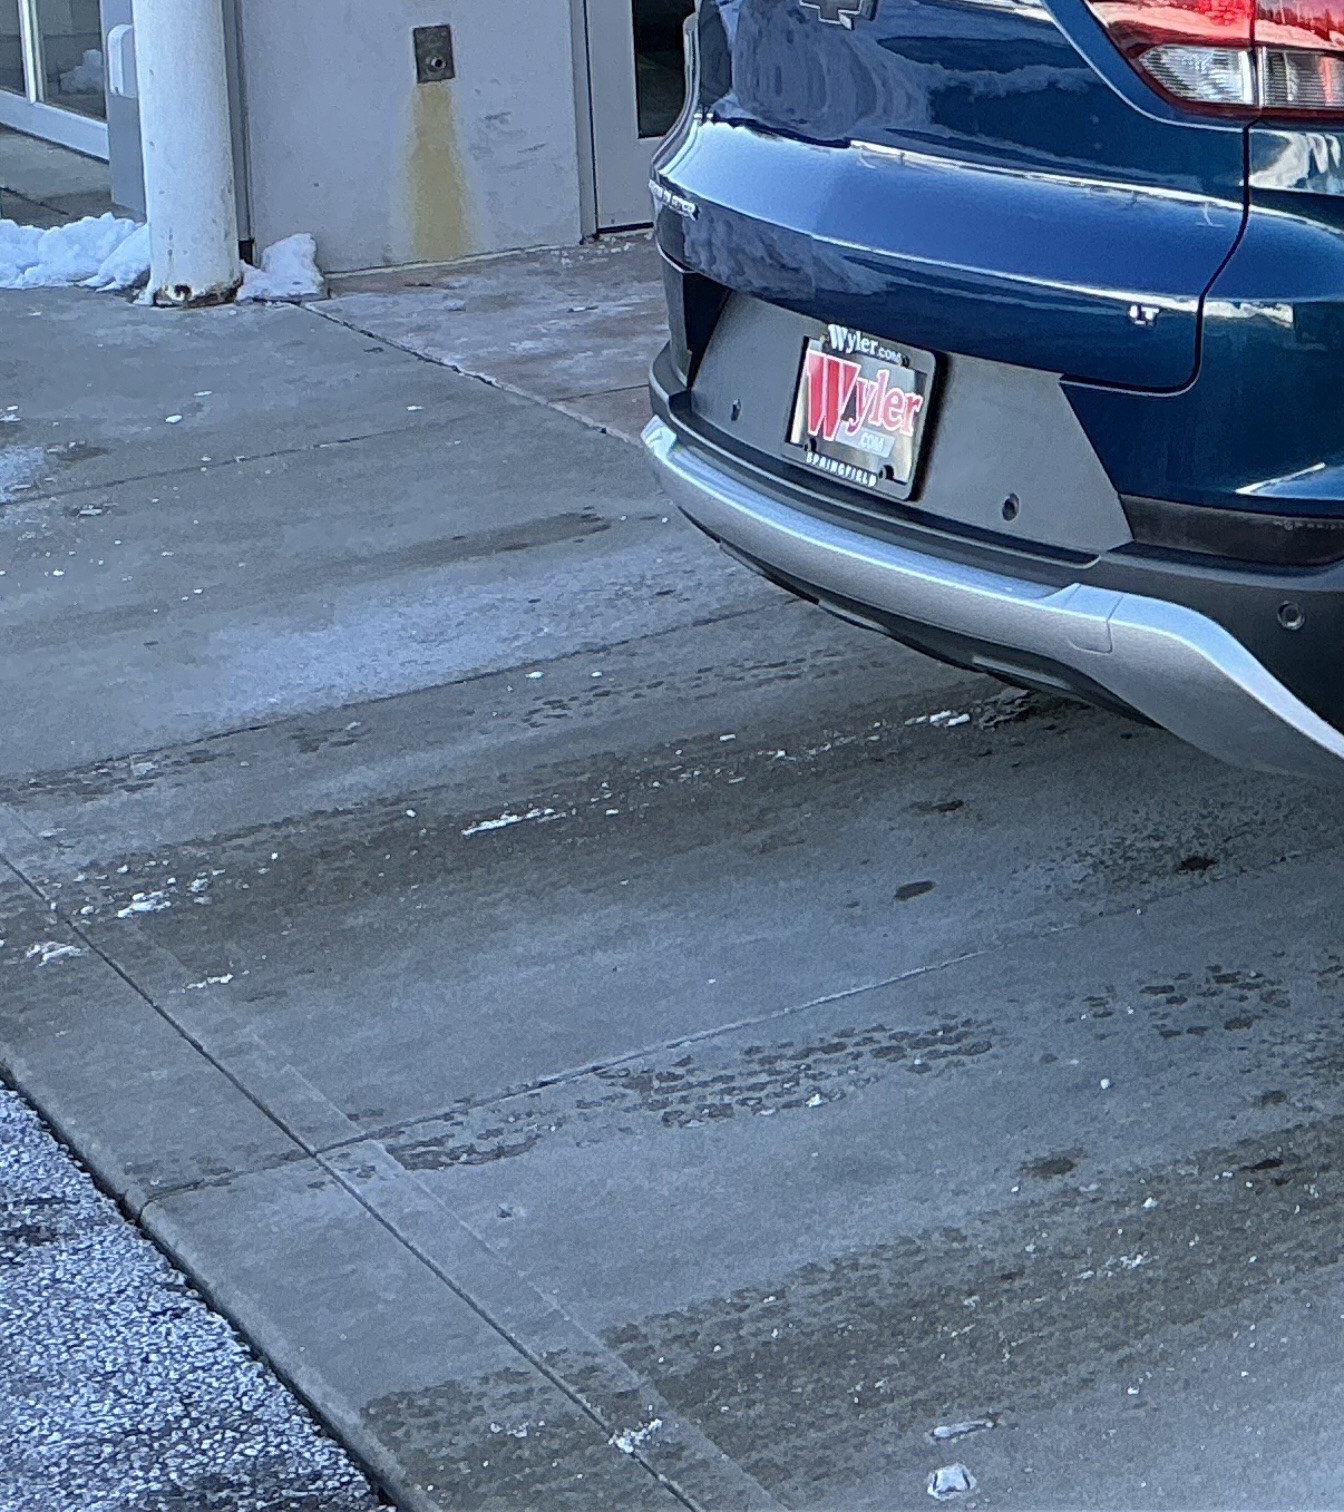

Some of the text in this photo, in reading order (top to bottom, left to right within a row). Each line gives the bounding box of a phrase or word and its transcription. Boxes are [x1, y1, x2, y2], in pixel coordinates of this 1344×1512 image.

[1129, 304, 1160, 326] LT
[806, 349, 924, 442] Wyler
[806, 451, 878, 488] SPRINGFIELD
